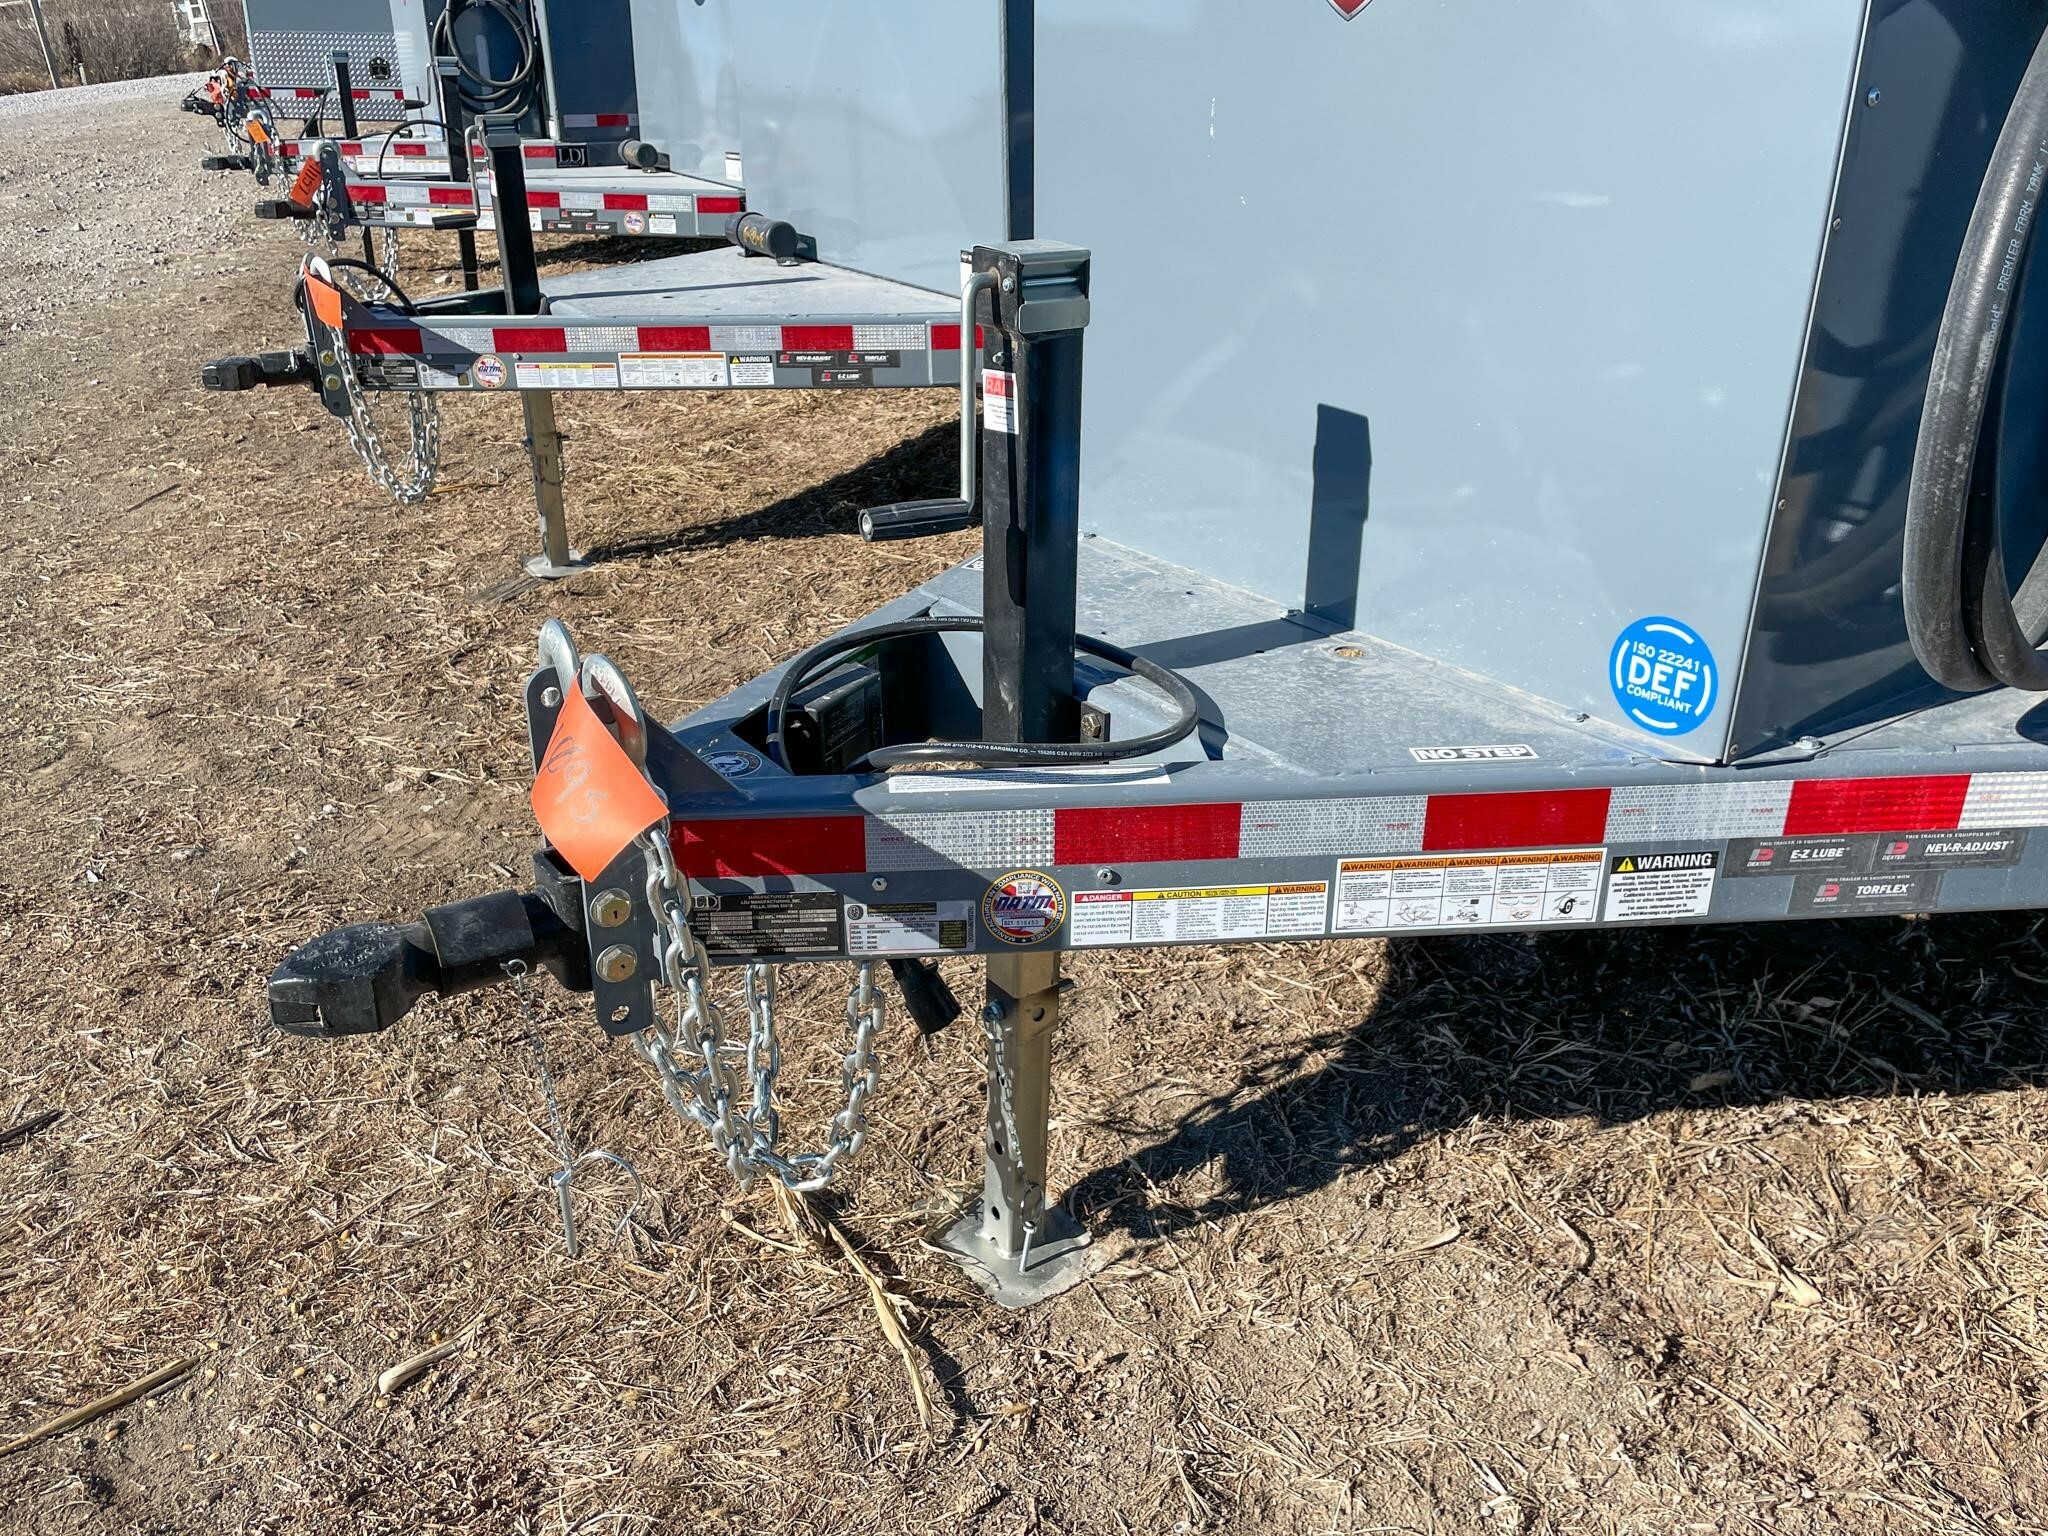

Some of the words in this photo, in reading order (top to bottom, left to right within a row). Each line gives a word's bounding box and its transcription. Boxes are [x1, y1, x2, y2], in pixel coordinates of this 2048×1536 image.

[558, 147, 586, 167] LDJ
[1996, 238, 2021, 292] PREMIER
[2014, 199, 2032, 234] FARM
[2026, 160, 2045, 193] TANK
[1633, 641, 1656, 658] ISO
[1657, 649, 1700, 673] 22241
[1628, 654, 1697, 699] DEF
[1626, 683, 1692, 714] COMPLIANT
[989, 745, 1018, 753] BARGMAN
[1417, 748, 1458, 760] NO
[1461, 746, 1528, 758] STEP
[1790, 849, 1811, 859] E-Z
[1812, 847, 1846, 858] LUBE
[1925, 841, 2009, 853] NEV-R-ADJUST
[1402, 860, 1445, 868] WARNING
[1455, 858, 1497, 866] WARNING
[1508, 856, 1549, 864] WARNING
[1560, 853, 1601, 861] WARNING
[1637, 853, 1713, 870] WARNING
[1350, 862, 1392, 870] WARNING
[994, 873, 1040, 890] COMPLIANCE
[1041, 876, 1057, 892] WITH
[1282, 885, 1321, 893] WARNING
[1856, 883, 1909, 895] TORFLEX
[1166, 890, 1202, 898] CAUTION
[693, 895, 722, 912] LDJ
[1055, 891, 1064, 913] NATM
[984, 897, 1016, 942] MANUFACTURED
[1030, 912, 1063, 940] GUIDELINES
